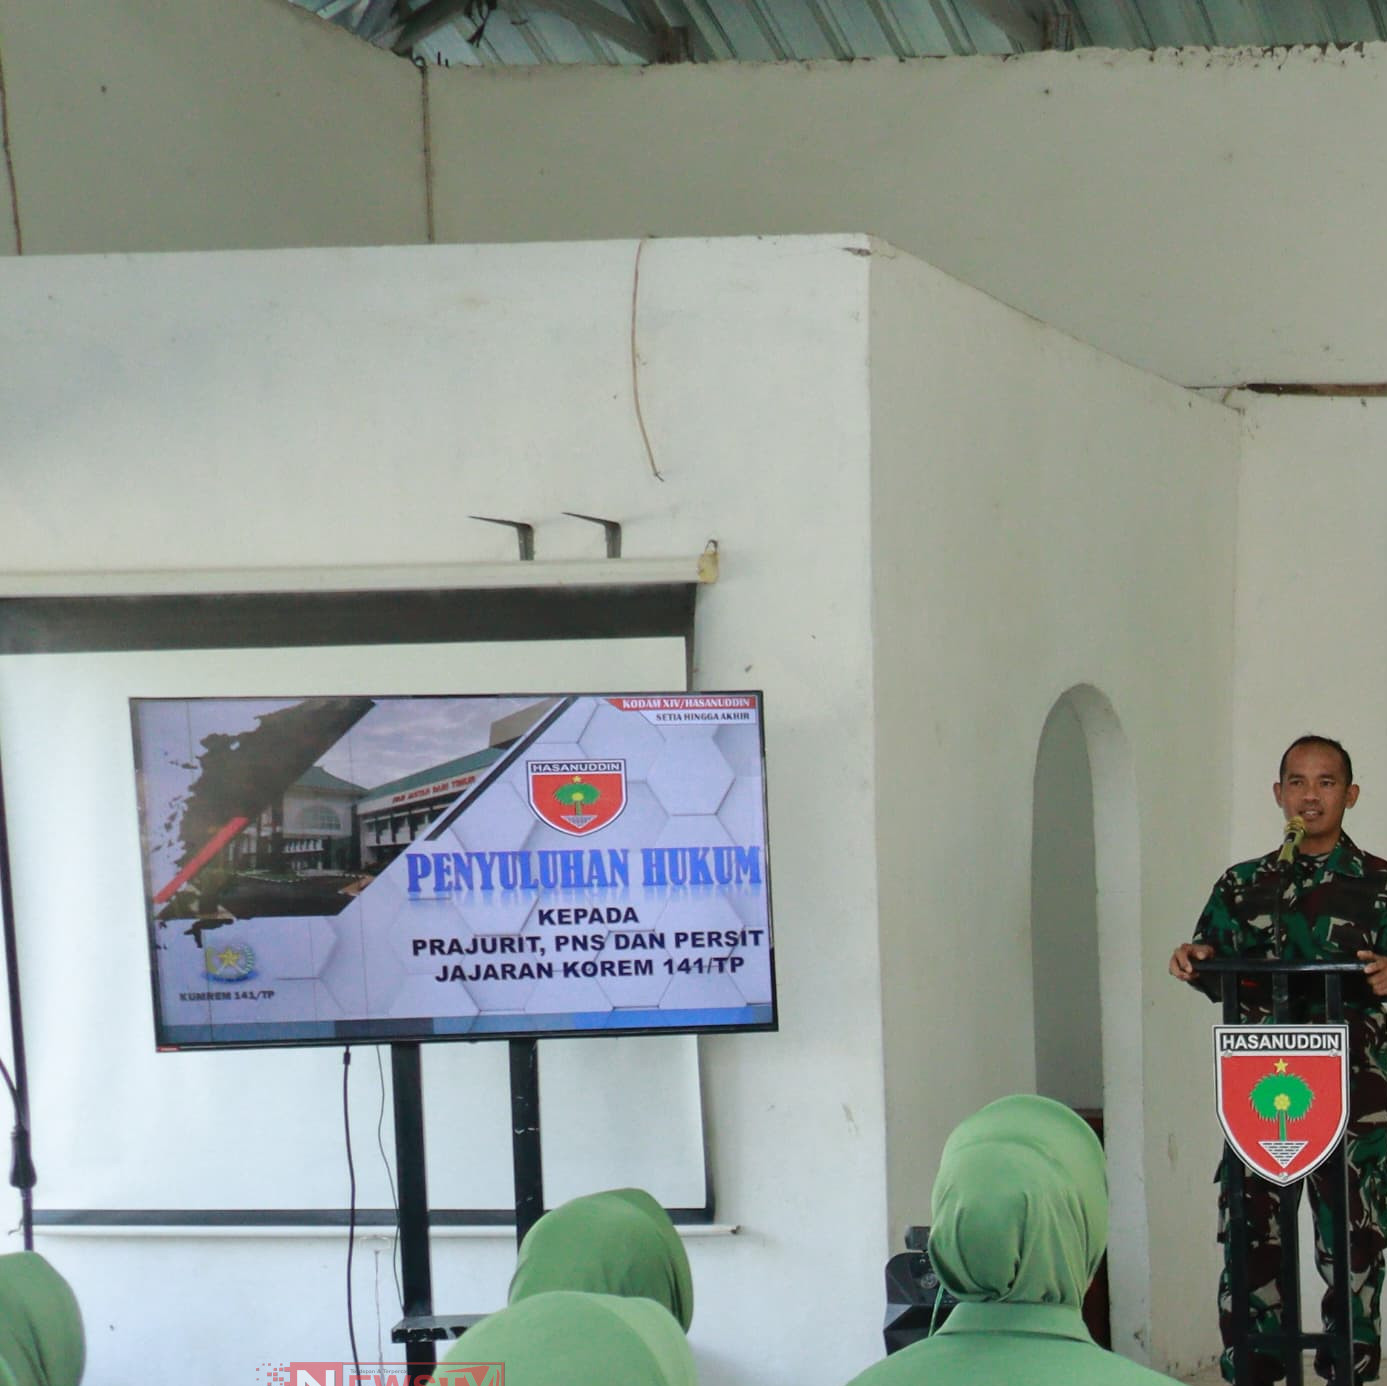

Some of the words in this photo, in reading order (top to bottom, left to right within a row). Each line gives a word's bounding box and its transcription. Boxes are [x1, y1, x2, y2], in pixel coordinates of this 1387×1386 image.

[623, 699, 660, 709] KODAM
[663, 698, 750, 709] XIV/HASANUDDIN
[656, 713, 682, 721] SETIA
[684, 713, 719, 721] HINGGA
[533, 763, 619, 772] HASANUDDIN
[407, 849, 629, 892] PENYULUHAN
[641, 846, 762, 887] HUKUM
[538, 907, 639, 926] KEPADA
[412, 936, 546, 956] PRAJURIT,
[555, 936, 605, 953] PNS
[614, 933, 665, 951] DAN
[674, 930, 764, 949] PERSIT
[435, 963, 554, 982] JAJARAN
[562, 960, 653, 979] KOREM
[663, 957, 745, 976] 141/TP
[1222, 1034, 1339, 1050] HASANUDDIN
